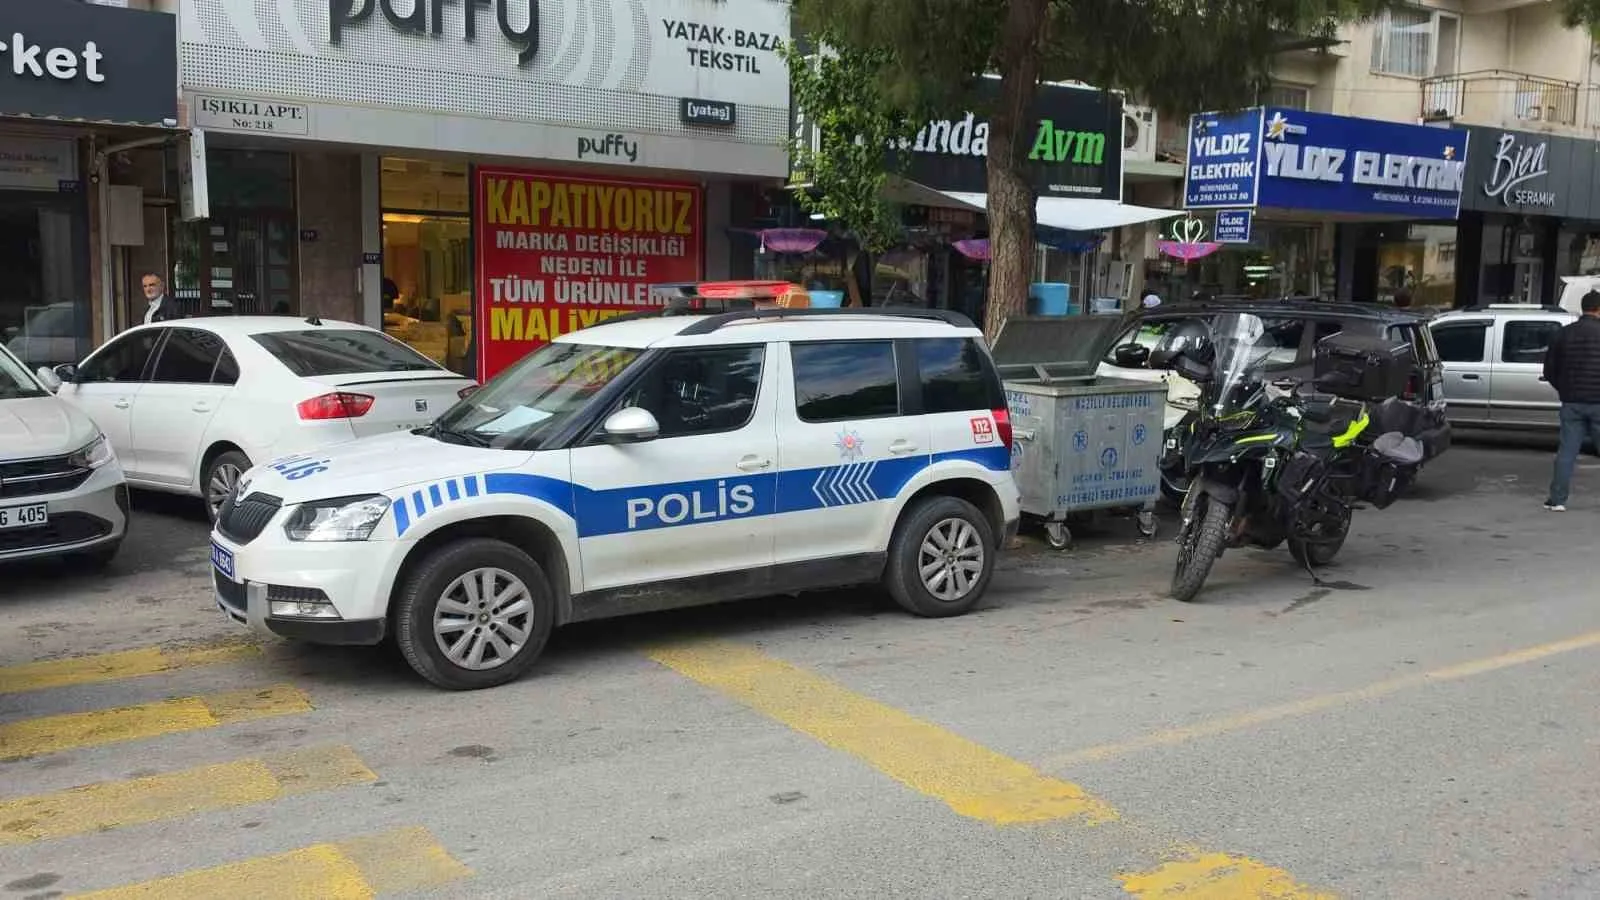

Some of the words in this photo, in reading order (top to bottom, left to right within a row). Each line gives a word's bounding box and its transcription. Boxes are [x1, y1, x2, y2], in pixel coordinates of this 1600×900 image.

[0, 32, 105, 82] ket
[686, 47, 761, 74] TEKSTİL
[201, 98, 259, 116] IŞIKLI
[263, 104, 303, 120] APT.
[232, 118, 253, 129] No:
[254, 119, 274, 130] 218
[577, 133, 637, 163] puffy
[1028, 119, 1106, 165] Avm
[1193, 132, 1252, 157] YILDIZ
[1190, 157, 1255, 180] ELEKTRİK
[1263, 141, 1347, 183] YILDIZ
[1484, 132, 1548, 202] Bien
[486, 178, 692, 234] KAPATIYORUZ
[496, 230, 569, 251] MARKA
[575, 233, 686, 257] DEĞİŞİKLİĞİ
[541, 255, 613, 276] NEDENİ
[619, 257, 648, 277] İLE
[490, 275, 545, 303] TÜM
[973, 419, 991, 433] 112
[18, 506, 46, 523] 405
[627, 479, 755, 529] POLİS
